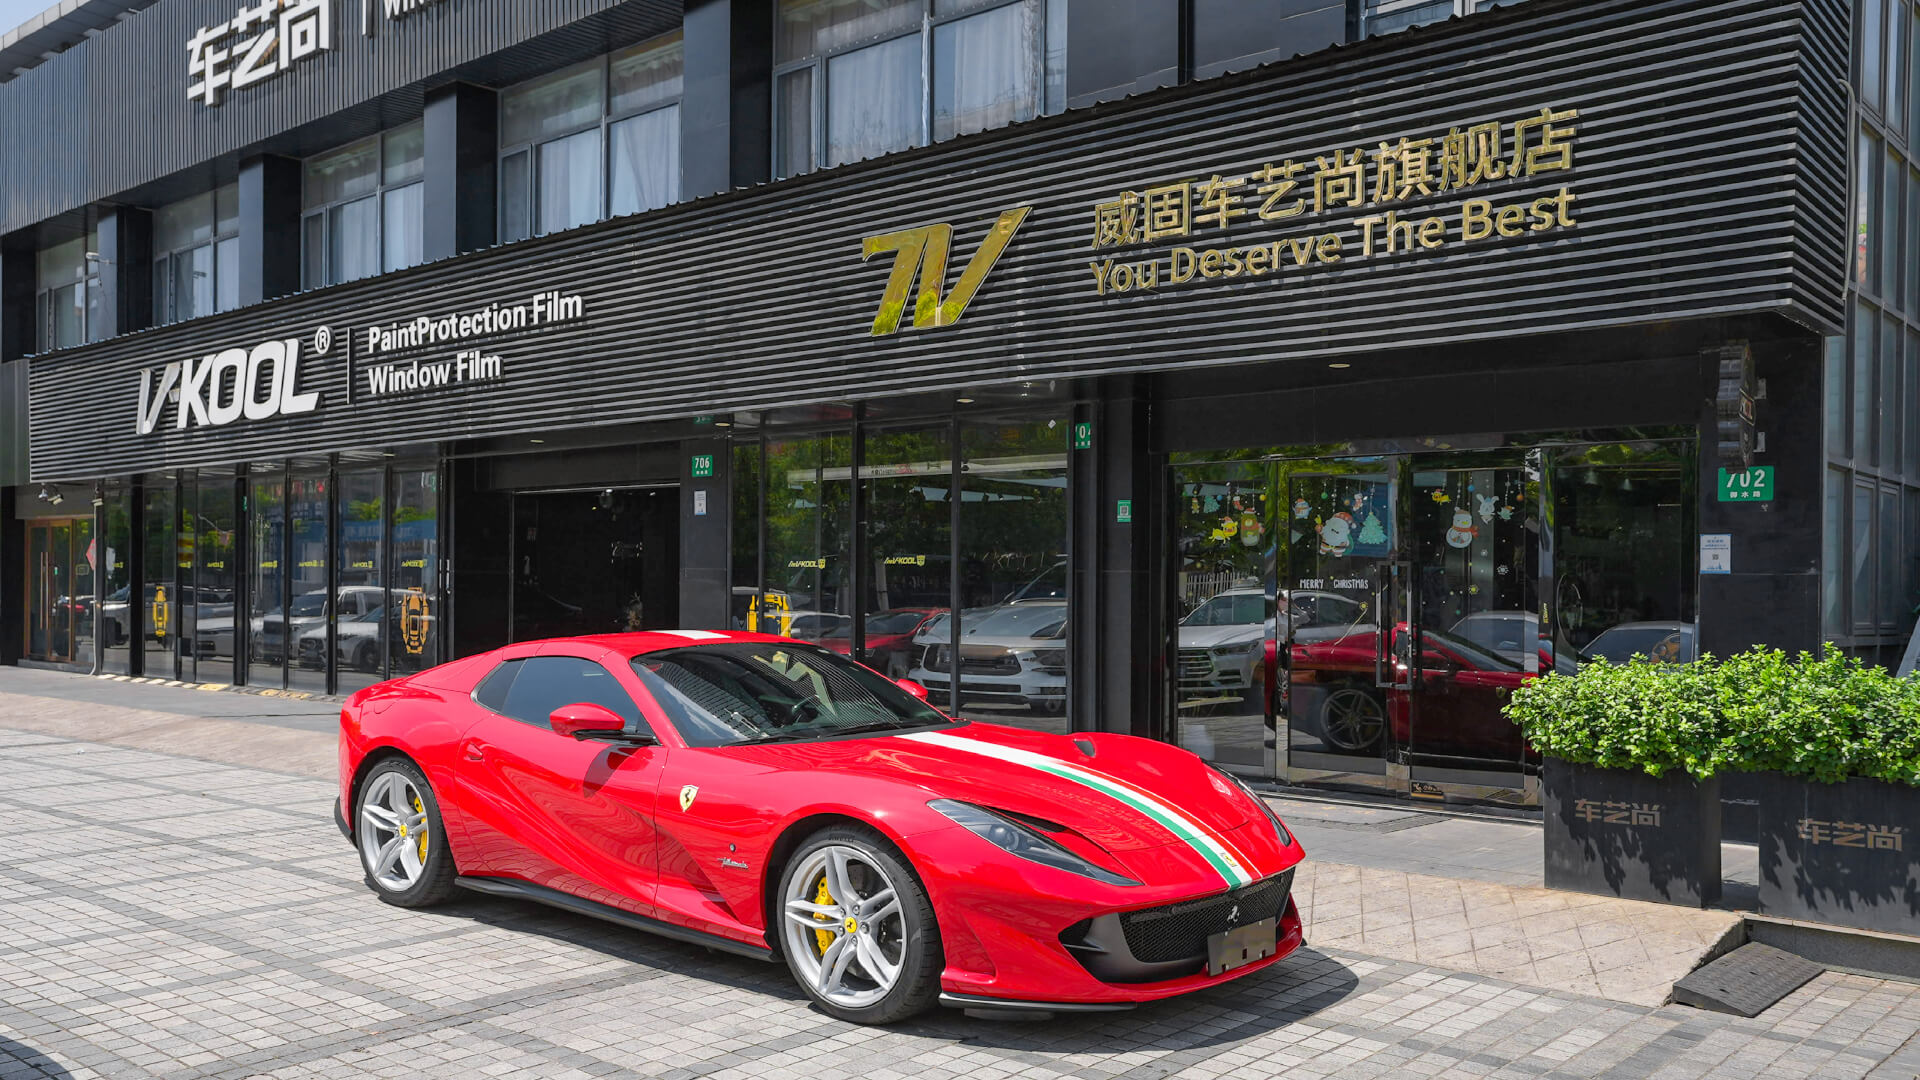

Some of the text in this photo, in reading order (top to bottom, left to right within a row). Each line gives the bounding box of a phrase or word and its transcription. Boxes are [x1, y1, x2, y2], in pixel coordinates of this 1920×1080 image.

[1090, 107, 1580, 250] 威固车艺尚旗舰店
[1089, 187, 1577, 295] You Deserve The Best
[532, 290, 583, 325] Film
[368, 351, 501, 396] Window Film
[694, 457, 710, 469] 706
[1299, 579, 1369, 590] MERRY CHRISTMAS
[1574, 799, 1661, 828] 车艺尚
[1796, 817, 1903, 853] 车艺尚
